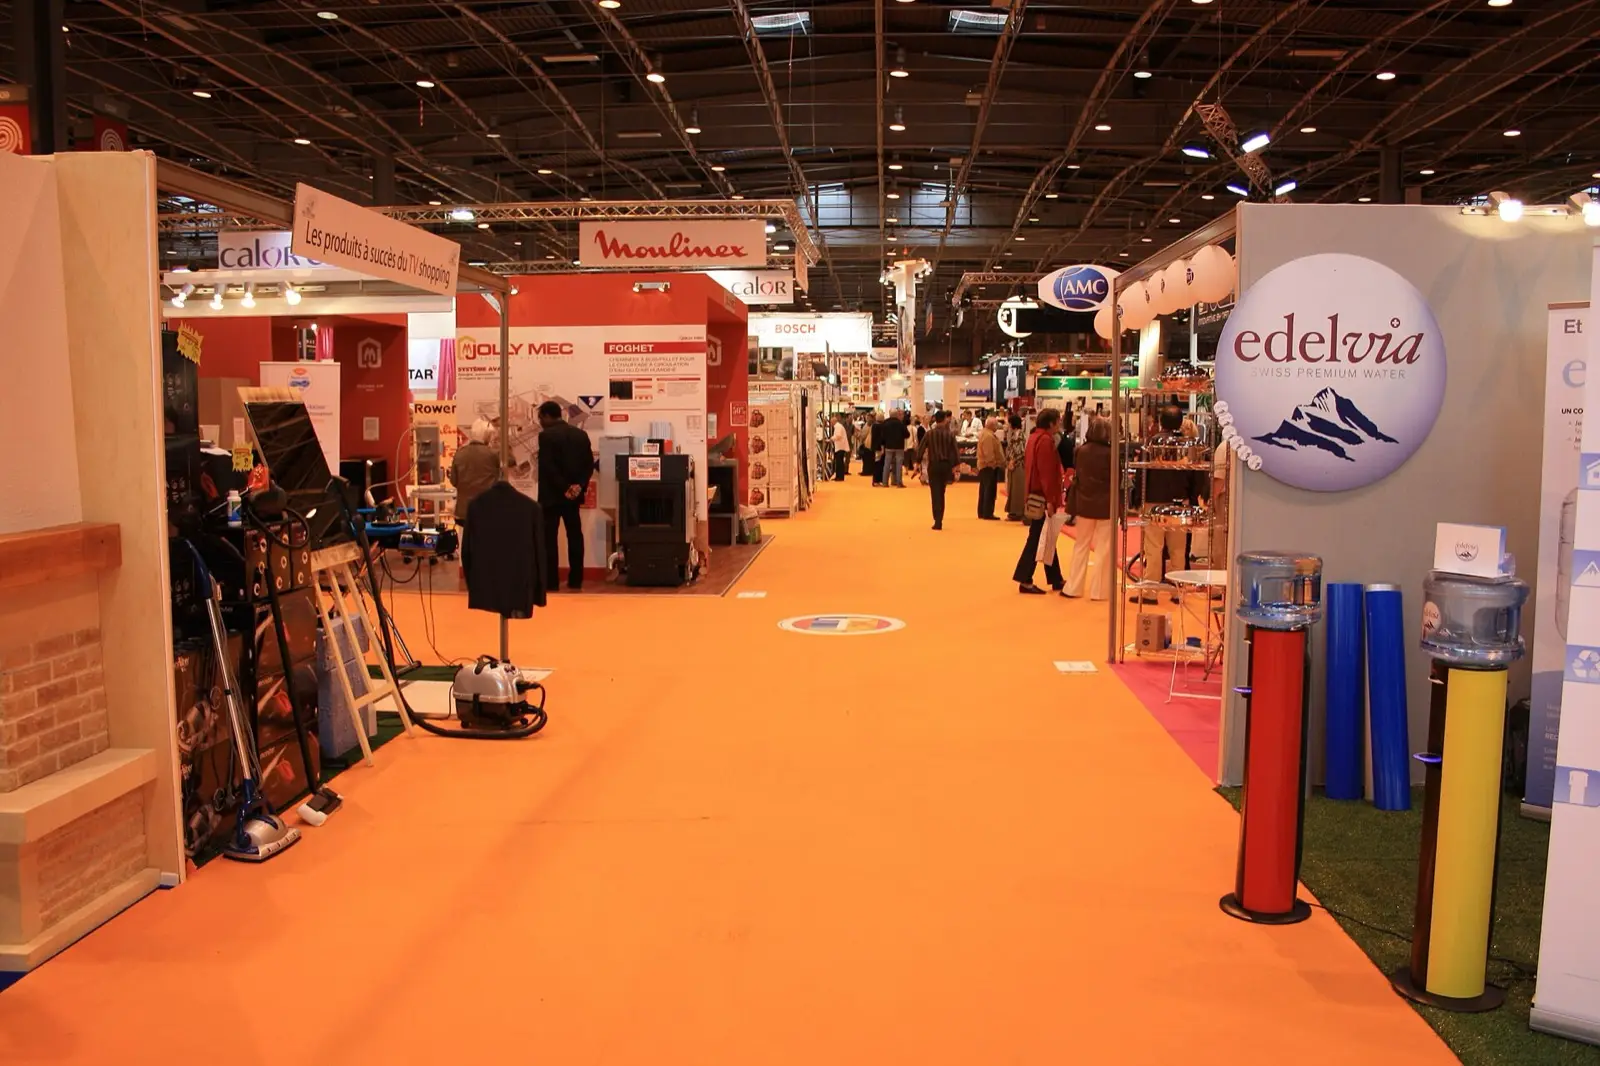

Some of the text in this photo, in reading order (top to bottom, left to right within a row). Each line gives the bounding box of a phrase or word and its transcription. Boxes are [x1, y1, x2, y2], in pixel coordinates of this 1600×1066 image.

[594, 230, 748, 259] Moulinex
[305, 220, 450, 290] Les produits à succès du TV shopping
[1063, 280, 1105, 295] AMC
[774, 324, 817, 335] BOSCH
[1564, 319, 1583, 334] Et
[1234, 312, 1425, 365] edelvia
[528, 343, 573, 355] MEC
[609, 344, 654, 353] FOGHET
[1251, 368, 1406, 379] SWISS PREMIUM WATER
[414, 404, 456, 414] Rower
